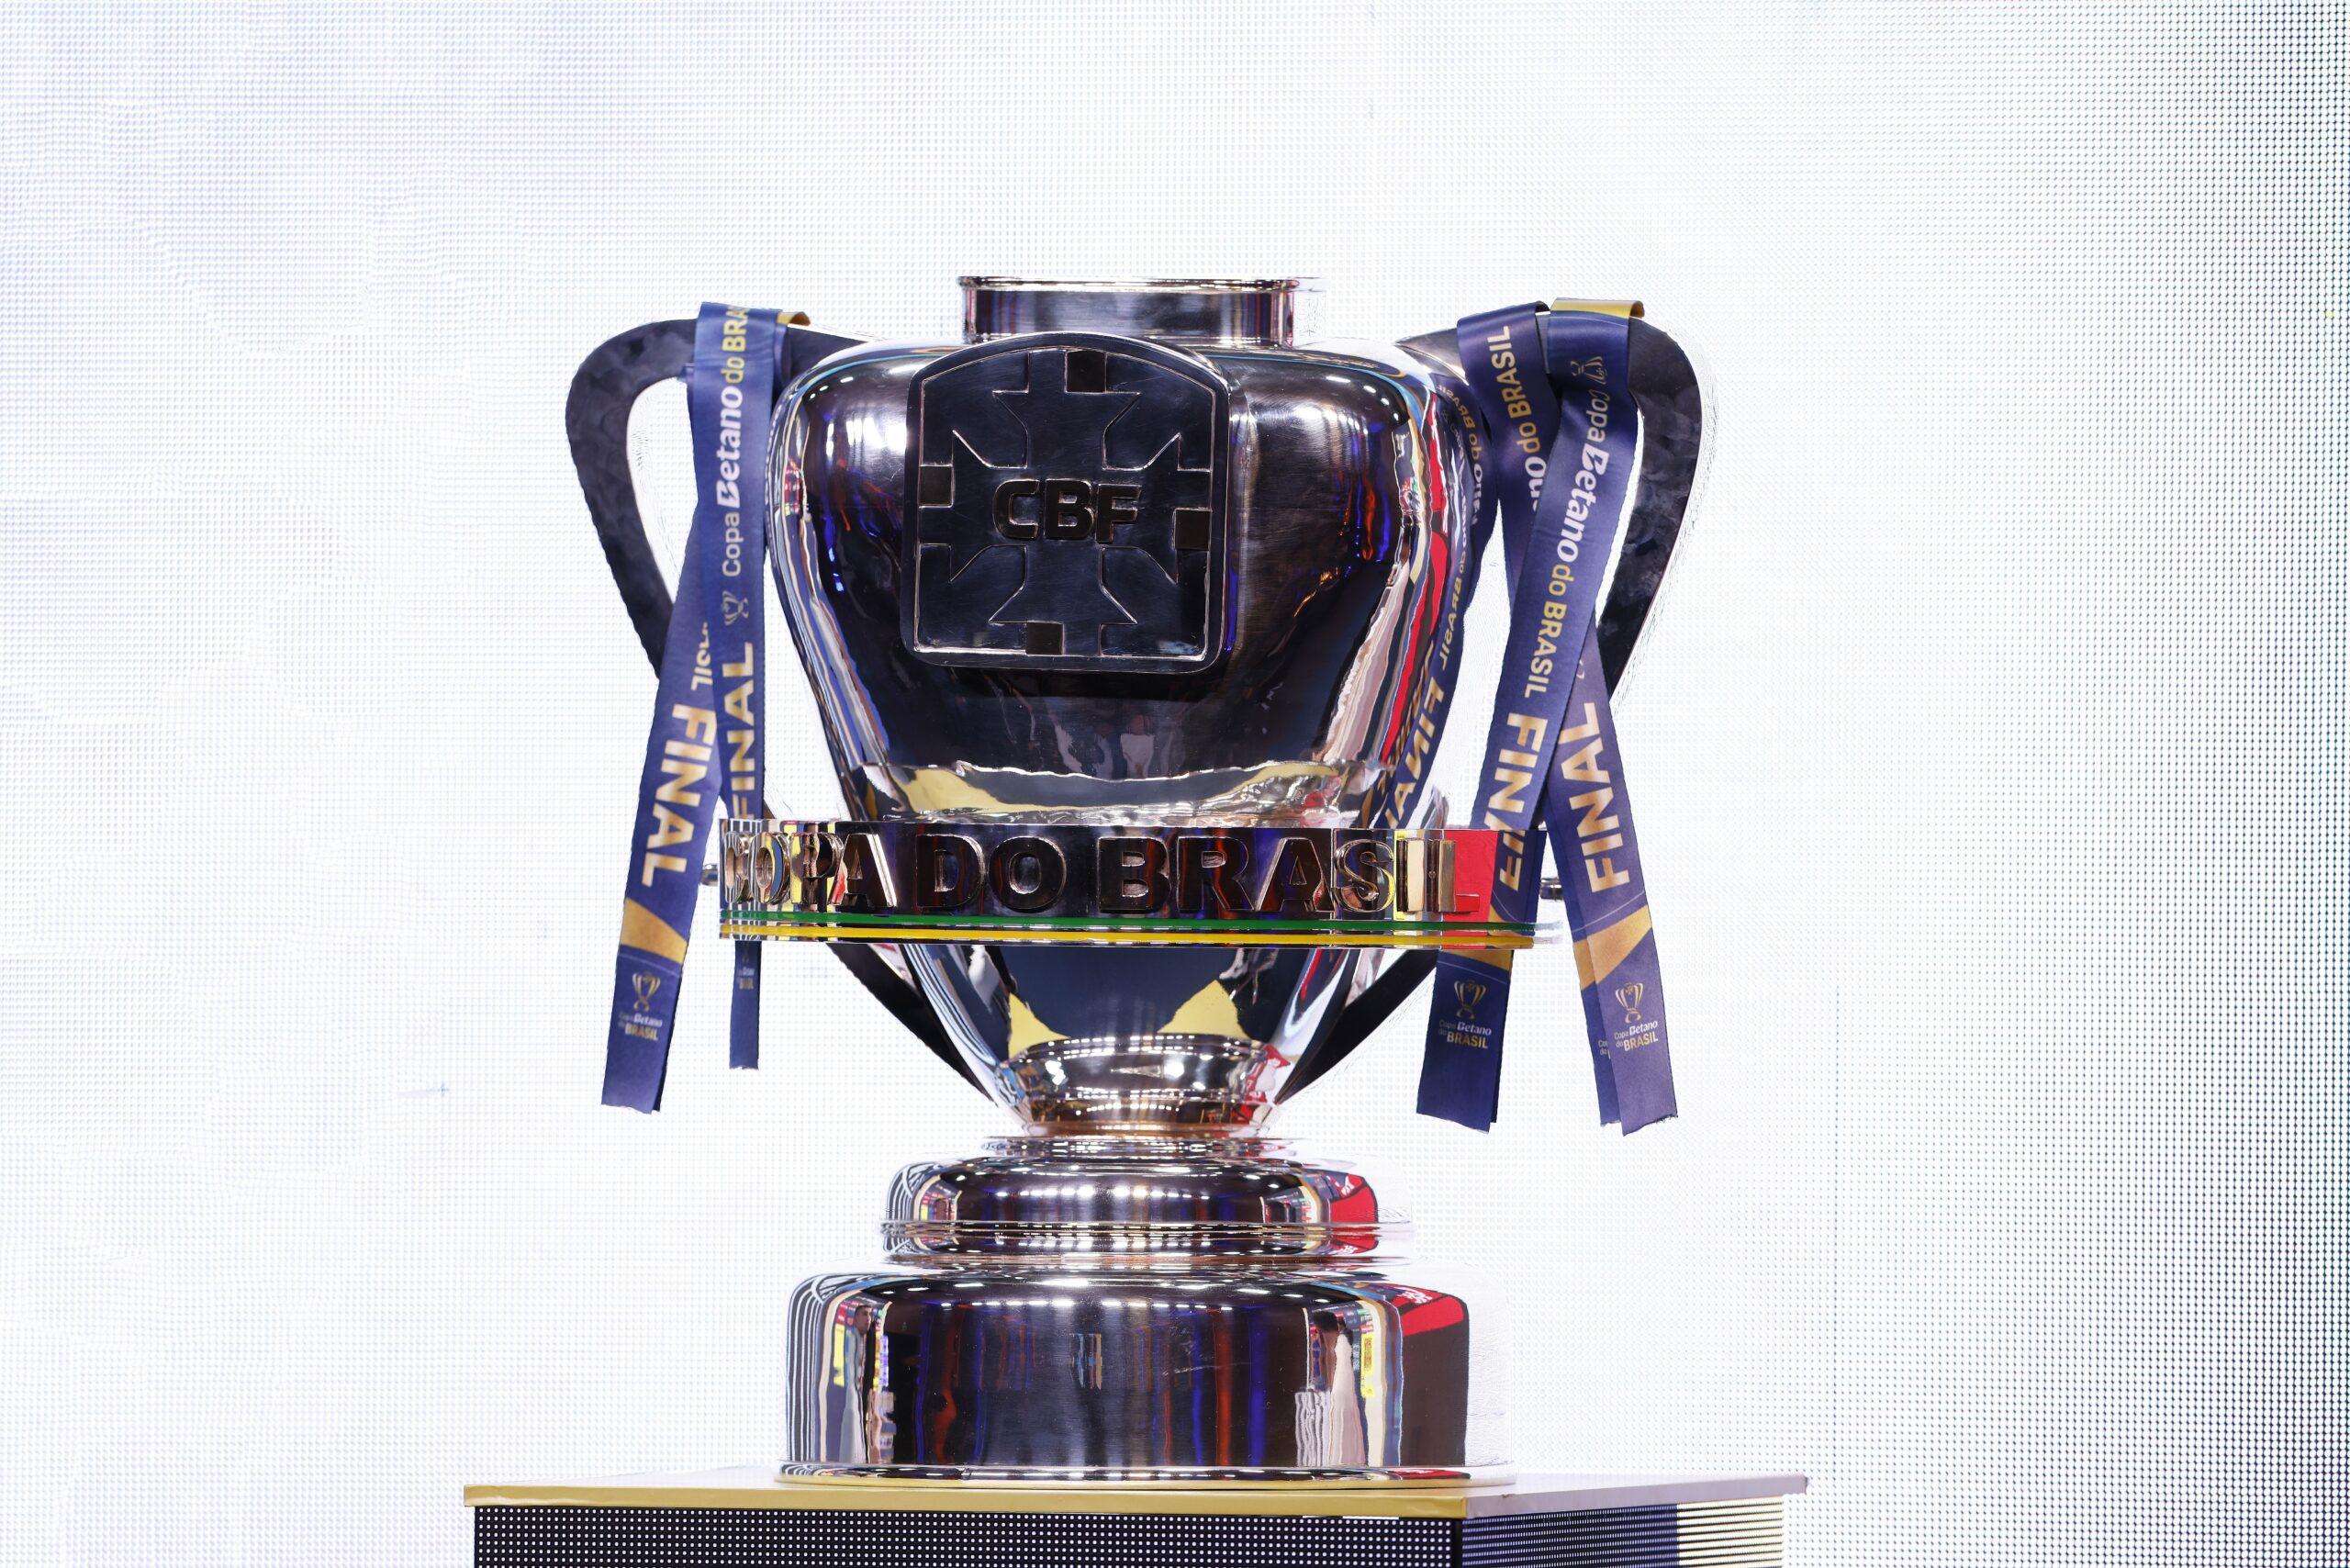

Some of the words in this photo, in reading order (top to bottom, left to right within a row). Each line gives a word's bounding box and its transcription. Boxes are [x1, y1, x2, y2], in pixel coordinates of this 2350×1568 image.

[721, 356, 745, 384] do
[1487, 325, 1533, 420] BRASIL
[716, 386, 743, 508] Betano
[1516, 422, 1541, 454] do
[1586, 389, 1610, 442] Copa
[992, 479, 1142, 543] CBF
[1557, 442, 1610, 563] Betano
[722, 513, 744, 577] Copa
[1549, 564, 1574, 596] do
[1525, 600, 1567, 698] BRASIL
[643, 703, 717, 887] FINAL
[1559, 702, 1630, 892] FINAL
[723, 832, 898, 908] COPA
[918, 833, 1067, 912] DO
[1101, 836, 1480, 913] BRASIL
[1447, 1031, 1489, 1048] BRASIL
[1457, 1021, 1492, 1036] Betano
[1614, 1031, 1629, 1040] Copa
[1628, 1020, 1659, 1036] Betano
[1623, 1031, 1659, 1051] BRASIL
